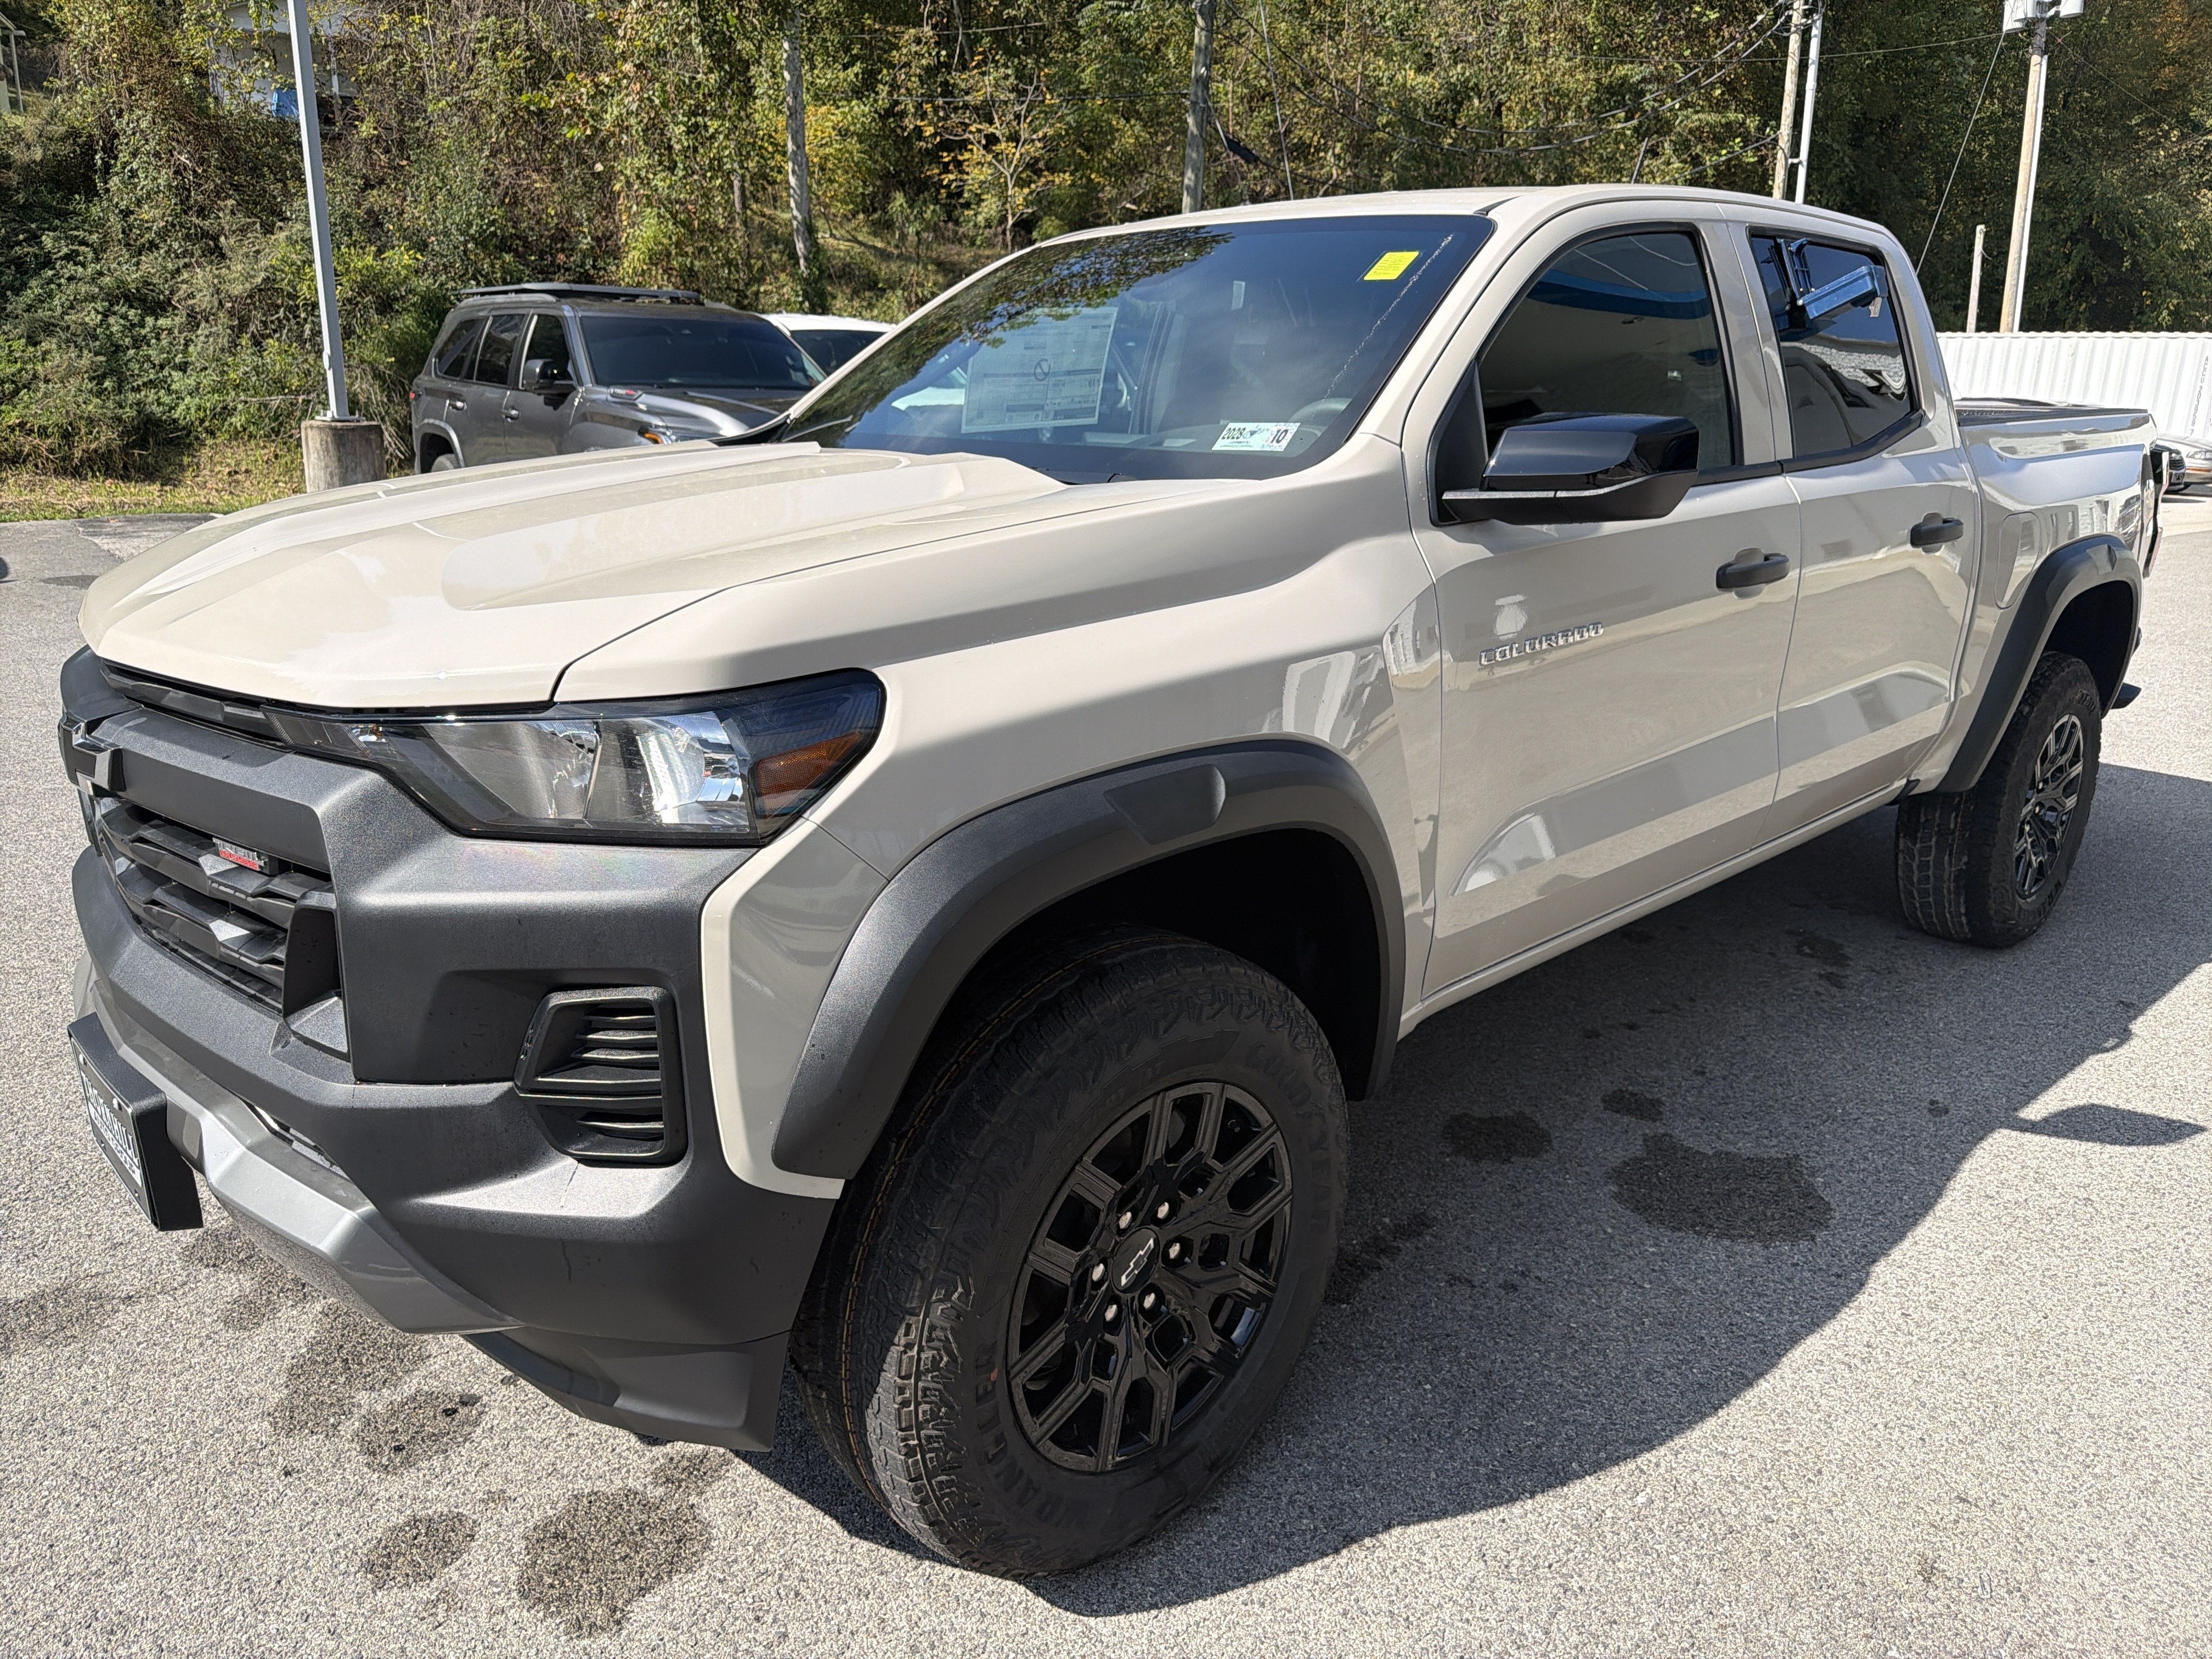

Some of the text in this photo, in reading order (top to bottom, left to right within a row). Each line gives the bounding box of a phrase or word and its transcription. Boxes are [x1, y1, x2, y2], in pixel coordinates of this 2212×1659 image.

[1221, 427, 1289, 444] 2028 10
[1479, 621, 1604, 666] COLORADO
[1243, 1041, 1332, 1236] GOODYEAR
[972, 1339, 1085, 1534] WRANGLER
